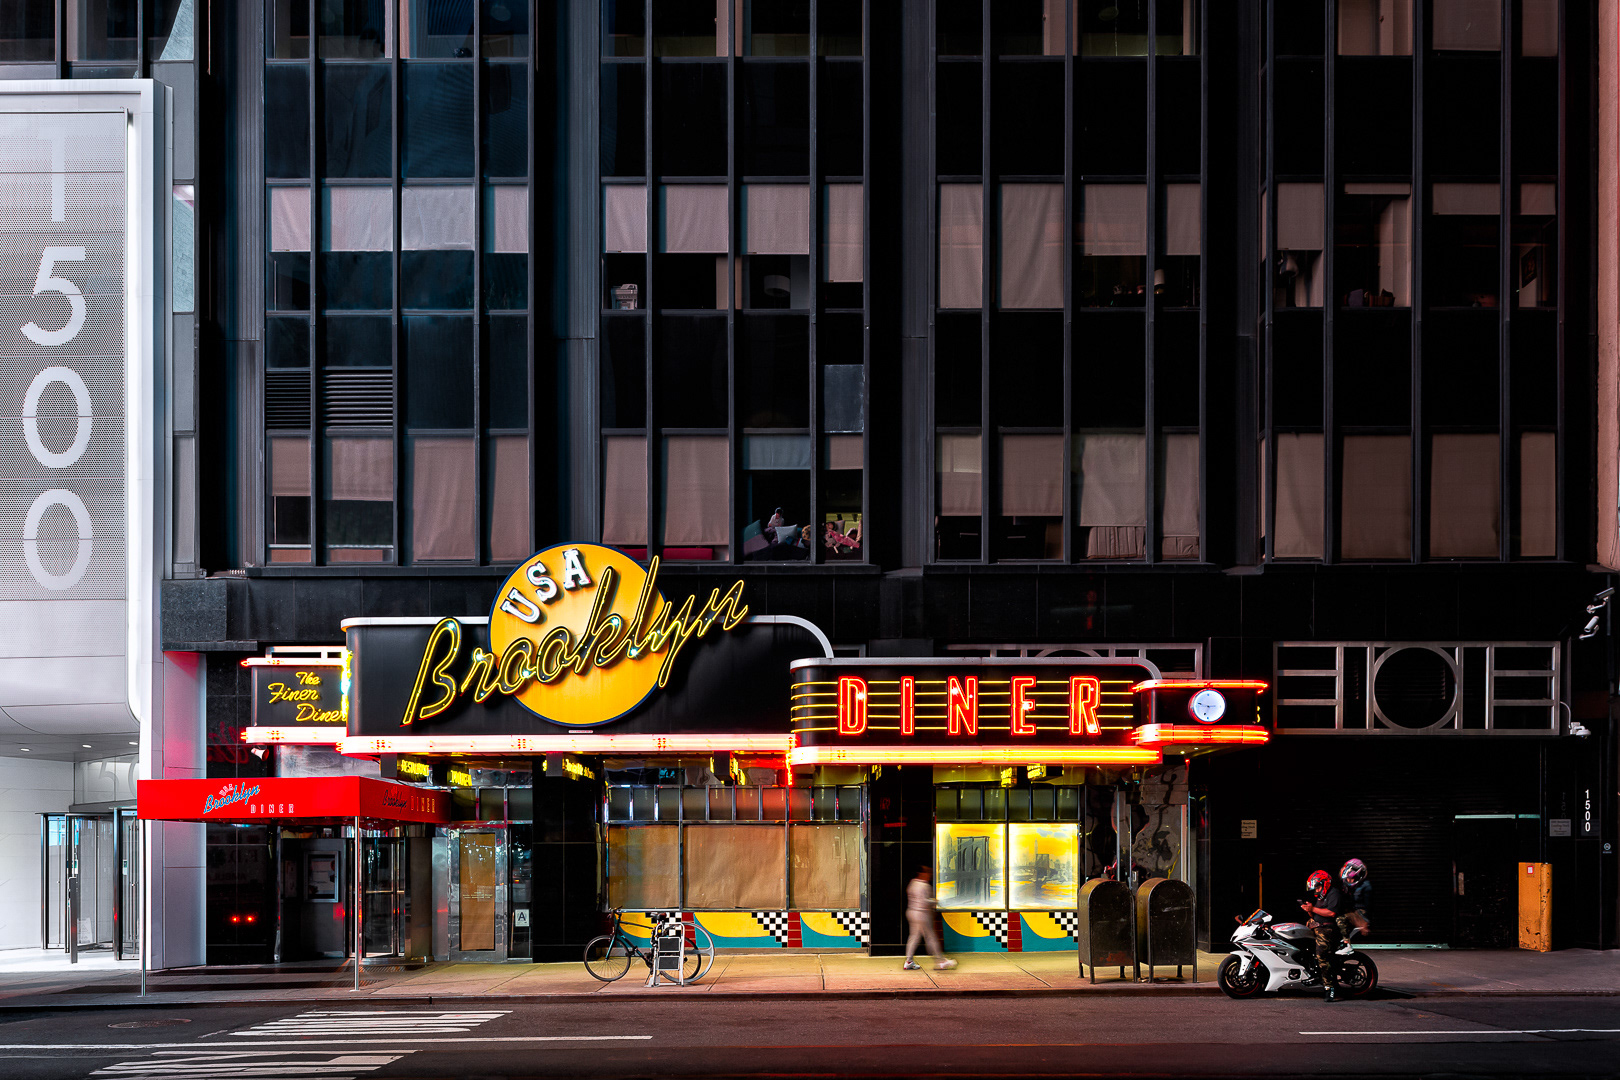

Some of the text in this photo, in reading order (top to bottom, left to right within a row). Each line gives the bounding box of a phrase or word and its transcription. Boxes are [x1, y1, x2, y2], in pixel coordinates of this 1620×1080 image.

[500, 548, 592, 625] USA
[400, 555, 749, 727] Brooklyn
[295, 672, 321, 685] The
[268, 682, 319, 704] Finer
[295, 703, 348, 722] Diner
[837, 675, 1101, 736] DINER
[203, 781, 261, 814] Brooklyn
[250, 803, 294, 814] DINER
[517, 911, 527, 921] A
